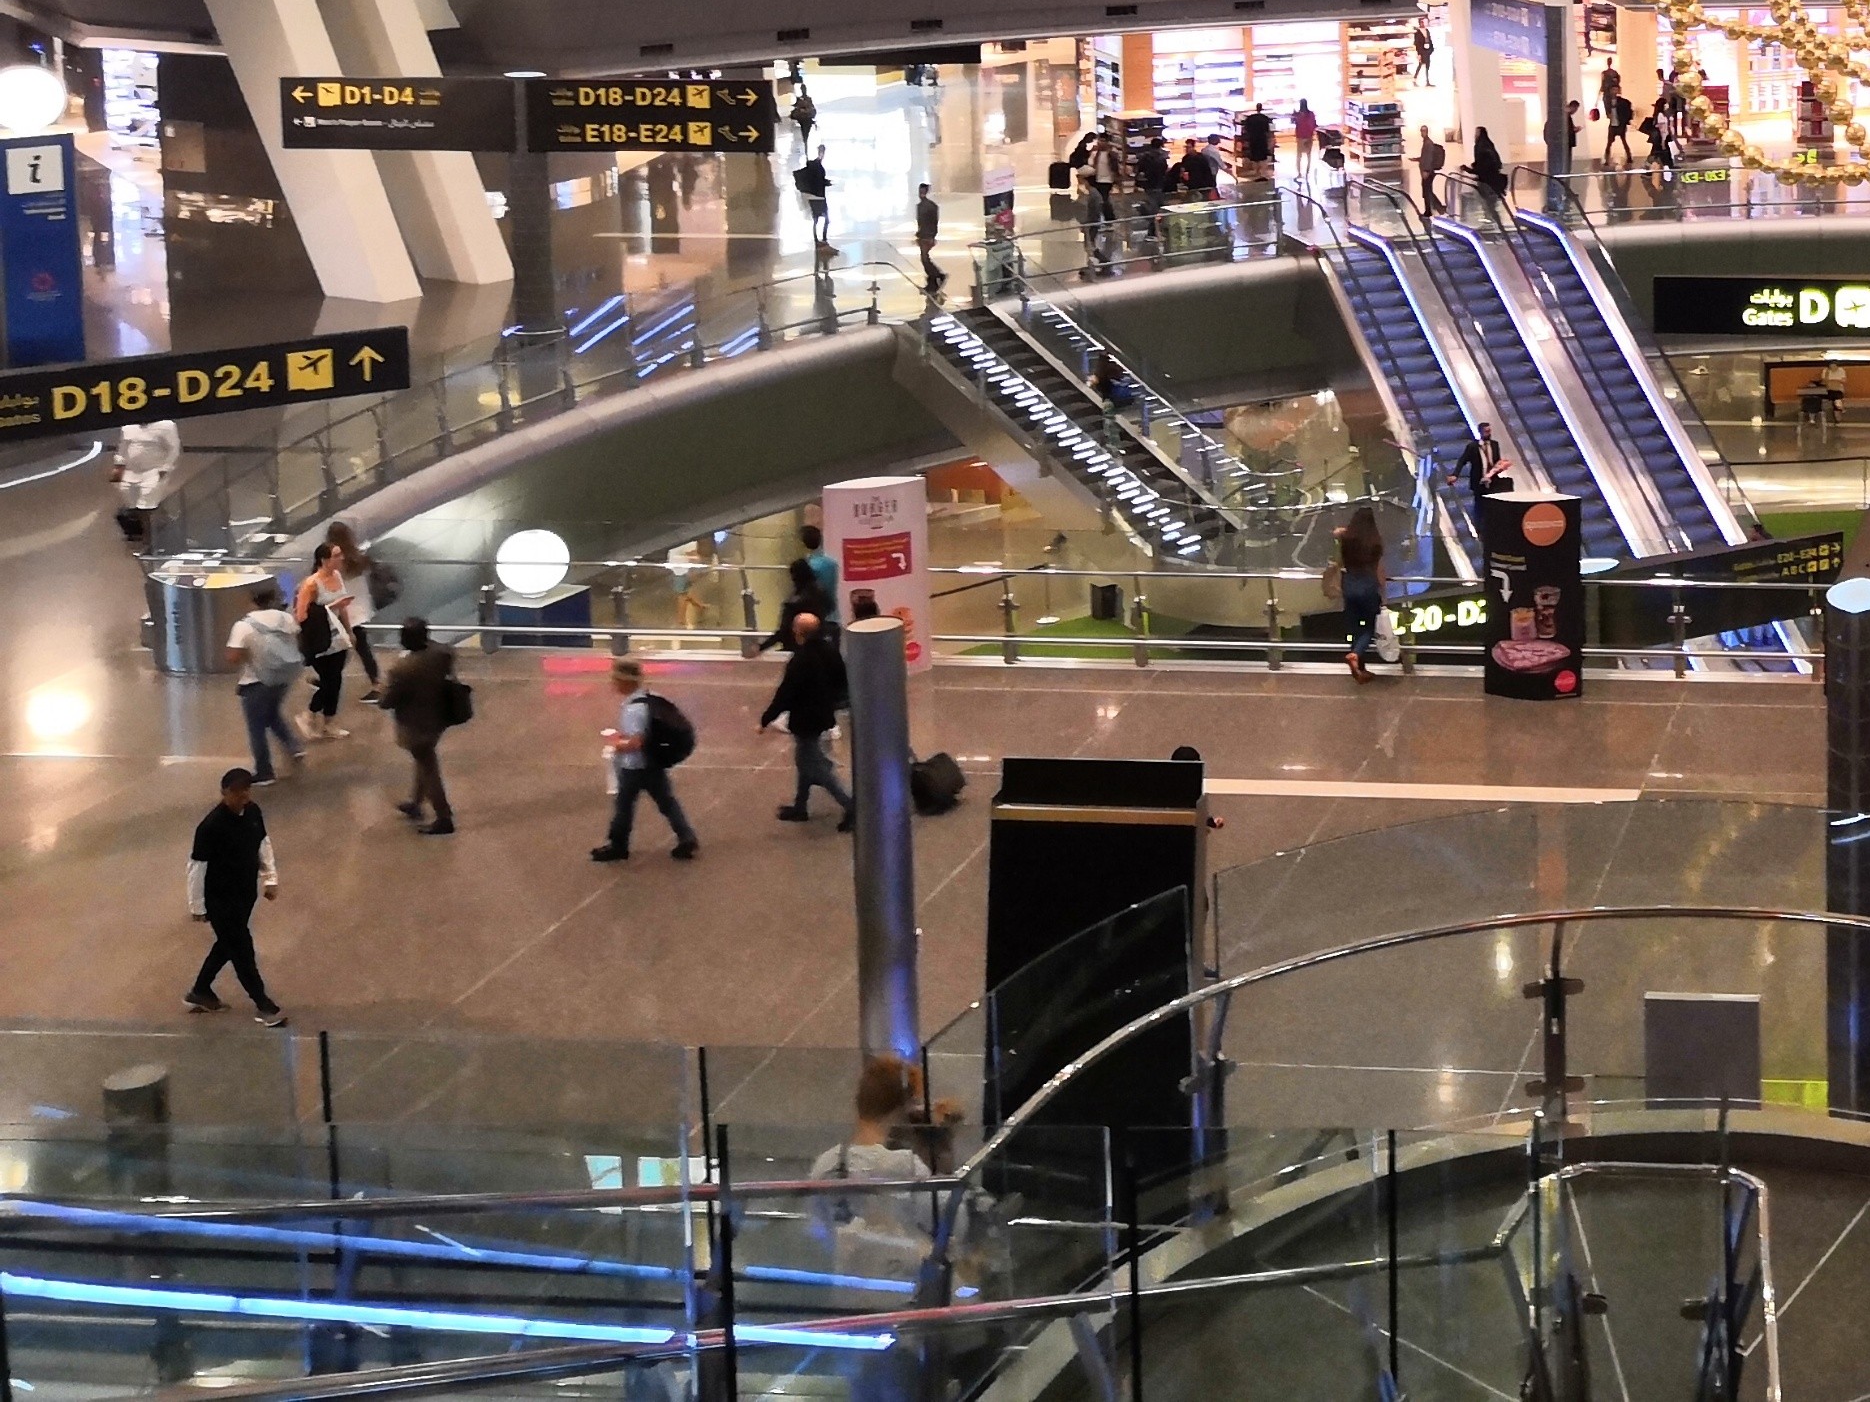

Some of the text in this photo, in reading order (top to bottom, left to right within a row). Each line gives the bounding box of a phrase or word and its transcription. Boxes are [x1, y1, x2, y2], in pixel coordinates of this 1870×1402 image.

[344, 86, 415, 105] D1-D4
[578, 87, 683, 106] D18-D24
[585, 123, 684, 143] E18-E24
[1742, 288, 1830, 327] Gates D
[51, 361, 275, 420] D18-D24
